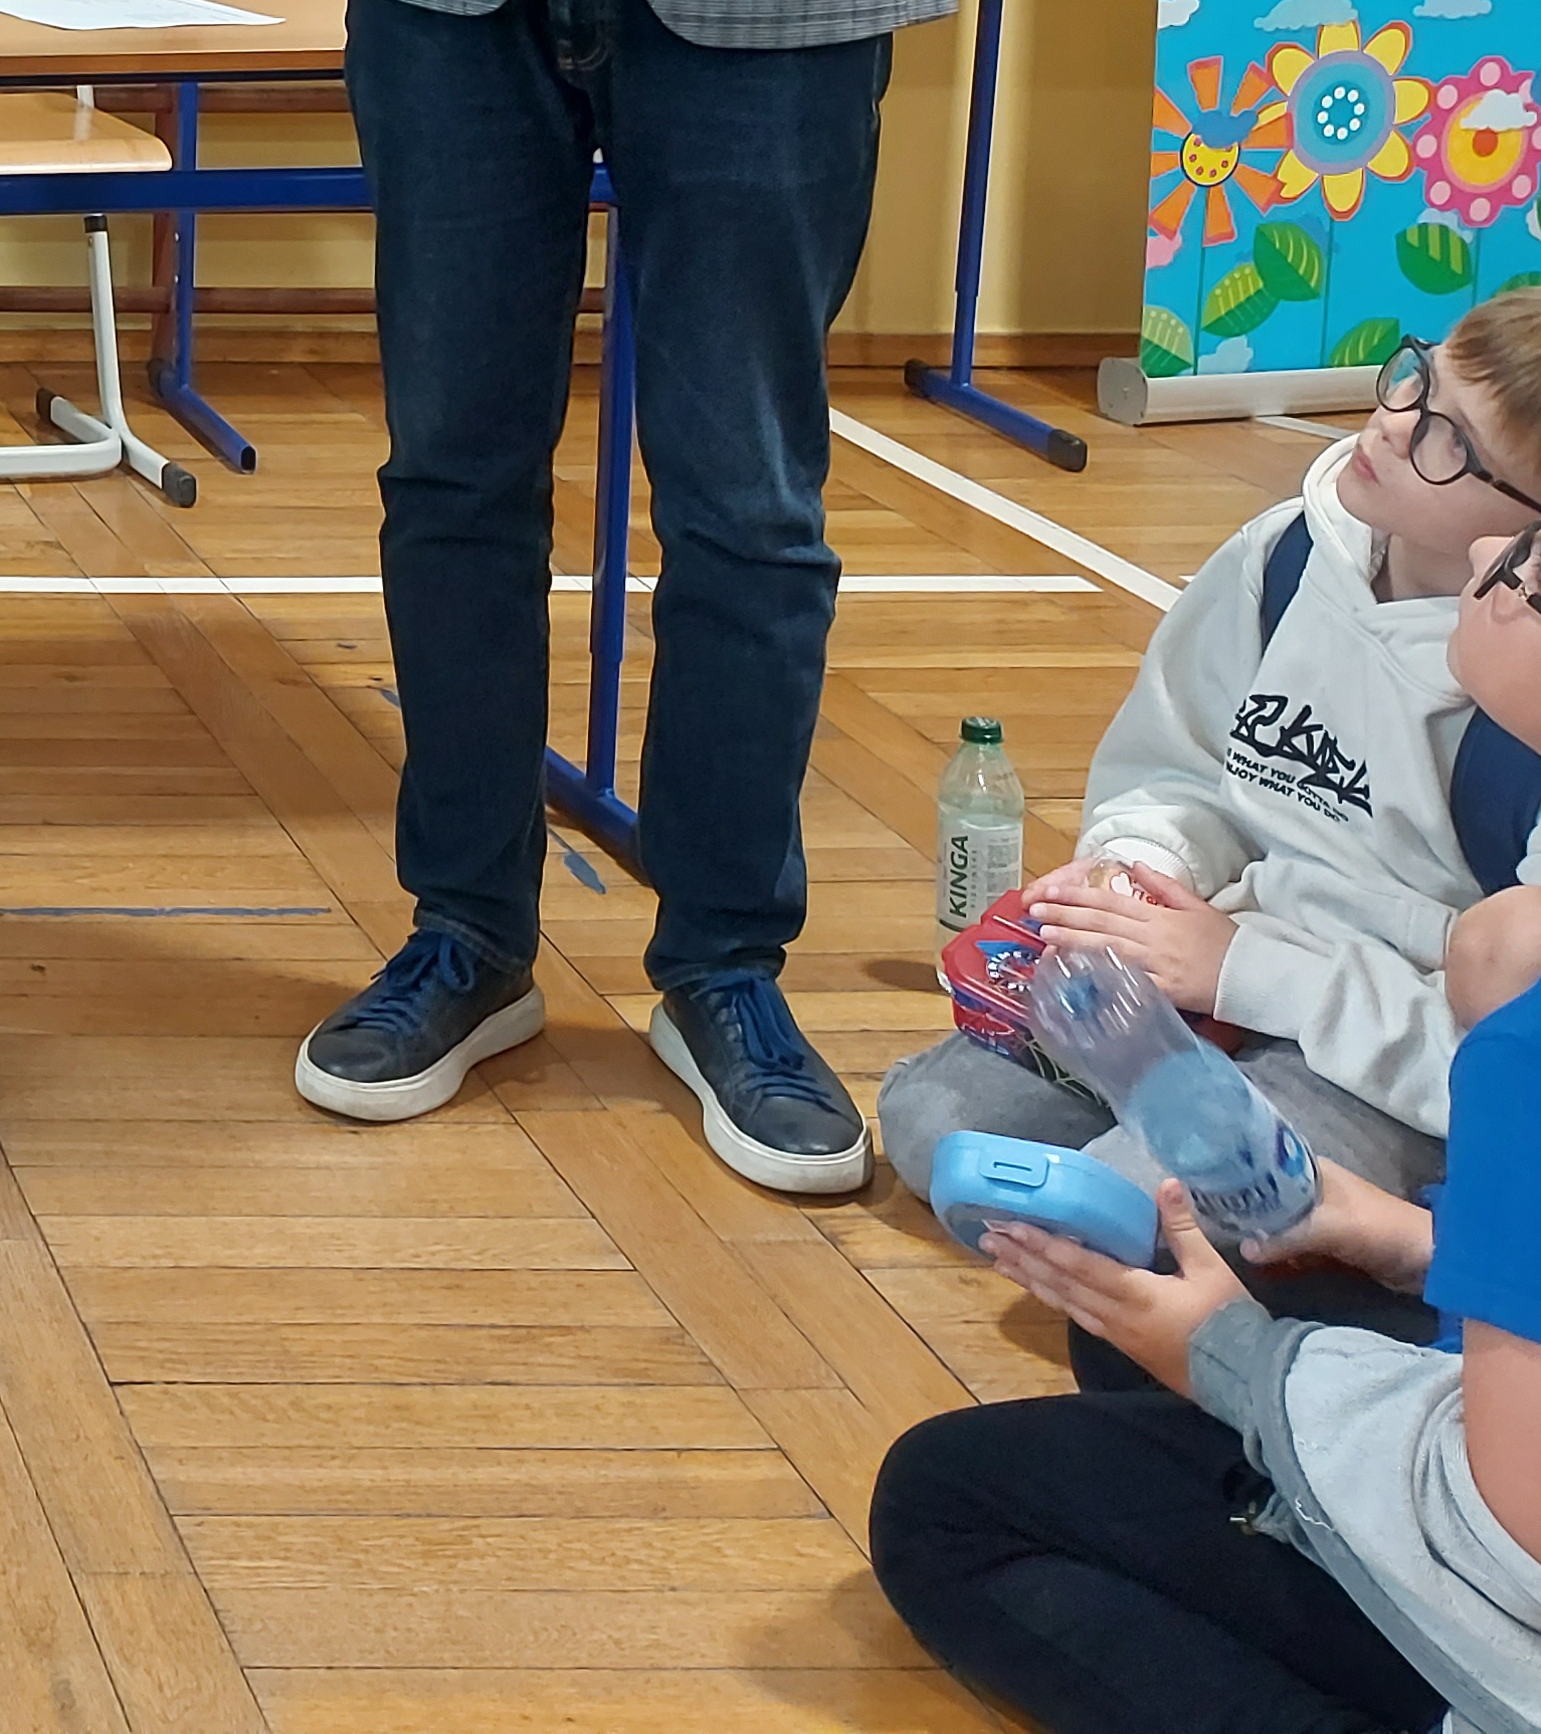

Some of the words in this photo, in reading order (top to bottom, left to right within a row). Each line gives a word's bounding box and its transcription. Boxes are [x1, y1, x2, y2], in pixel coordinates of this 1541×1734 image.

[1232, 751, 1267, 773] WHAT
[1271, 768, 1296, 783] YOU
[1259, 778, 1295, 797] WHAT
[1297, 792, 1321, 811] YOU
[949, 835, 969, 919] KINGA
